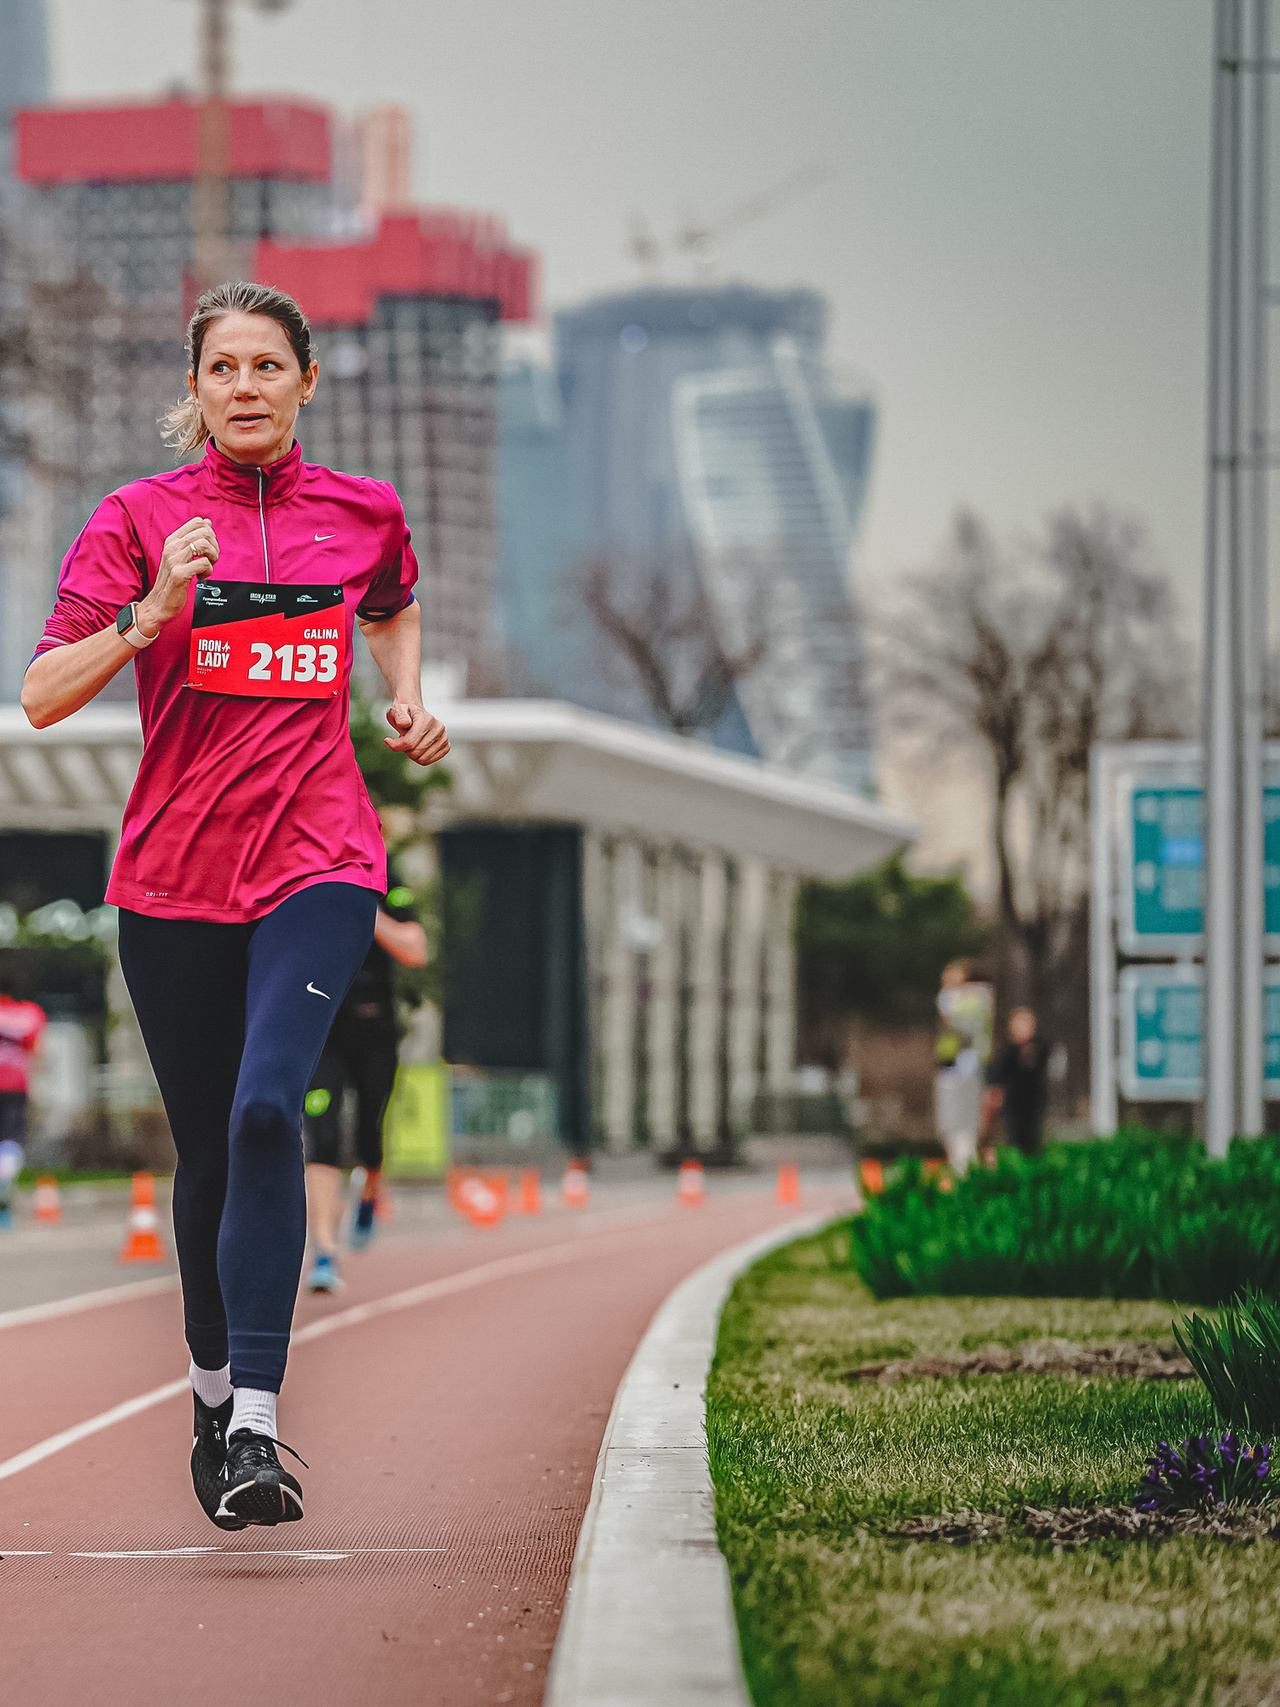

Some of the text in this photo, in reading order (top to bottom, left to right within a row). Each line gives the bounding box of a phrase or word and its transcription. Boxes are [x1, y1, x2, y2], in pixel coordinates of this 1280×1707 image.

[303, 628, 339, 640] GALINA
[198, 638, 222, 652] IRON
[197, 651, 230, 668] LADY
[248, 642, 338, 683] 2133
